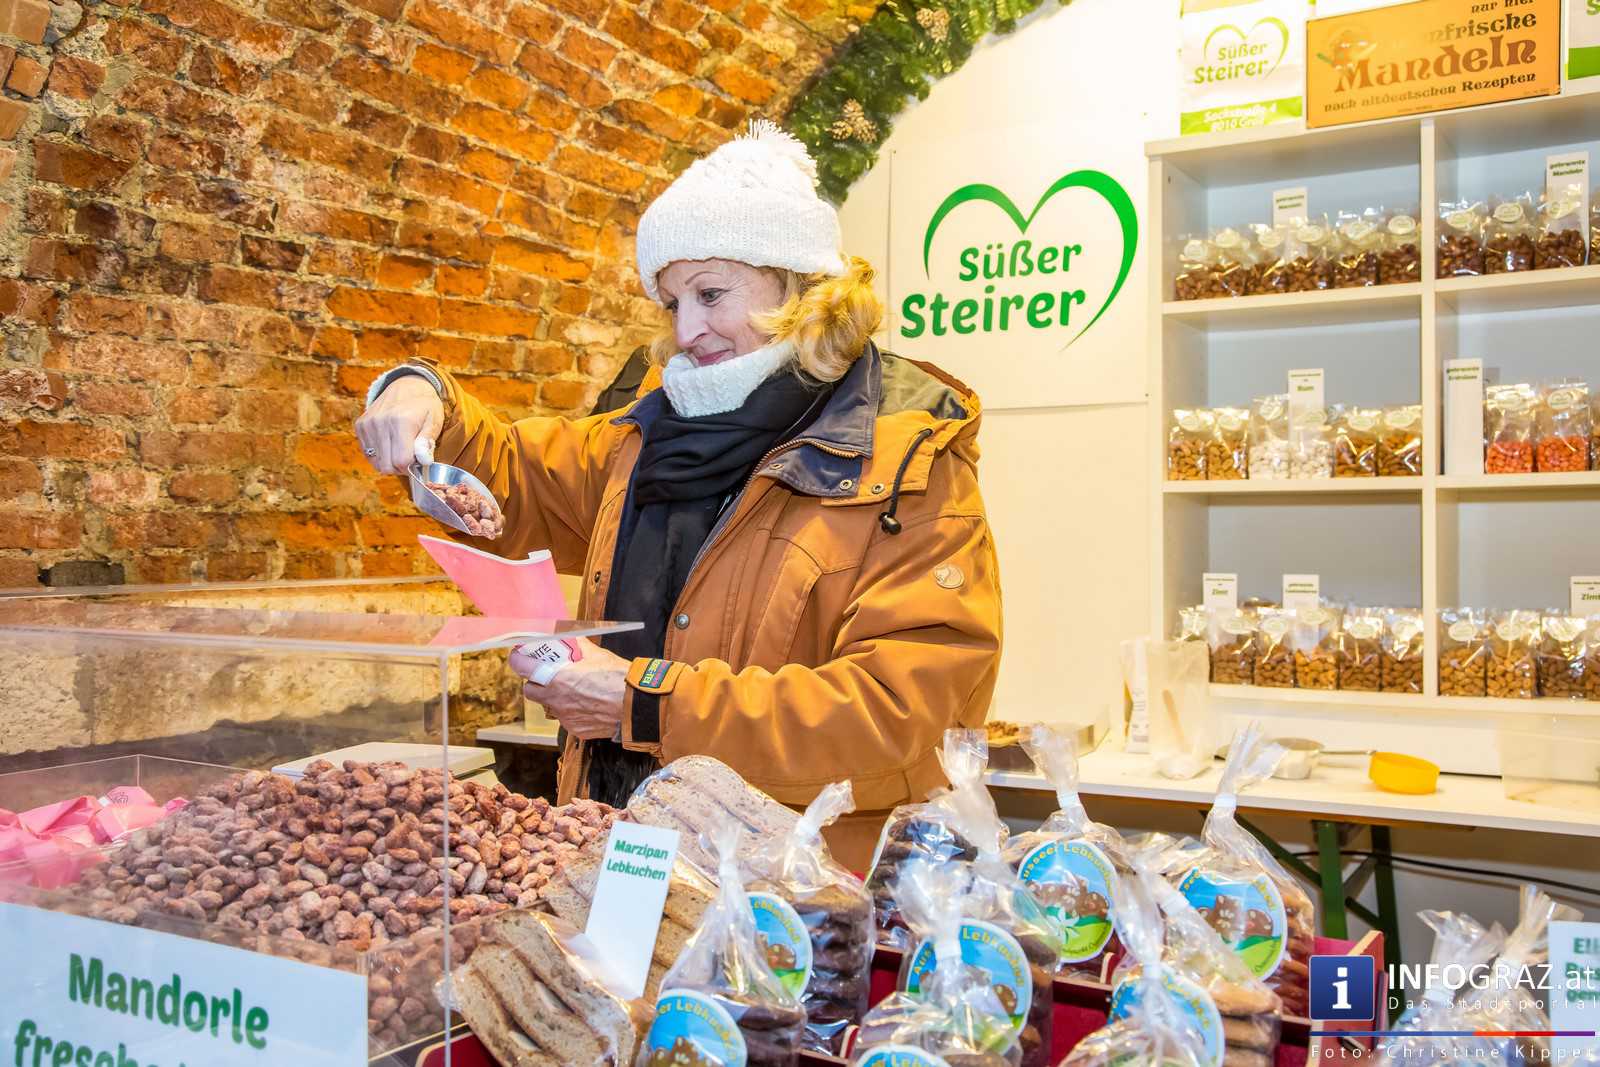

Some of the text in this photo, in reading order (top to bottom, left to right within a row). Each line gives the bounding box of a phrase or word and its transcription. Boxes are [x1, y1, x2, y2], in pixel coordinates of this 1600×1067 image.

[1218, 42, 1268, 61] Süßer
[1334, 35, 1536, 93] Mandeln
[1193, 60, 1269, 84] Steirer
[1462, 73, 1536, 91] Rezepten
[958, 240, 1082, 281] Süßer
[900, 285, 1086, 338] Steirer
[614, 840, 668, 859] Marzipan
[607, 858, 666, 880] Lebkuchen
[68, 953, 269, 1049] Mandorle
[14, 1019, 158, 1067] fresch
